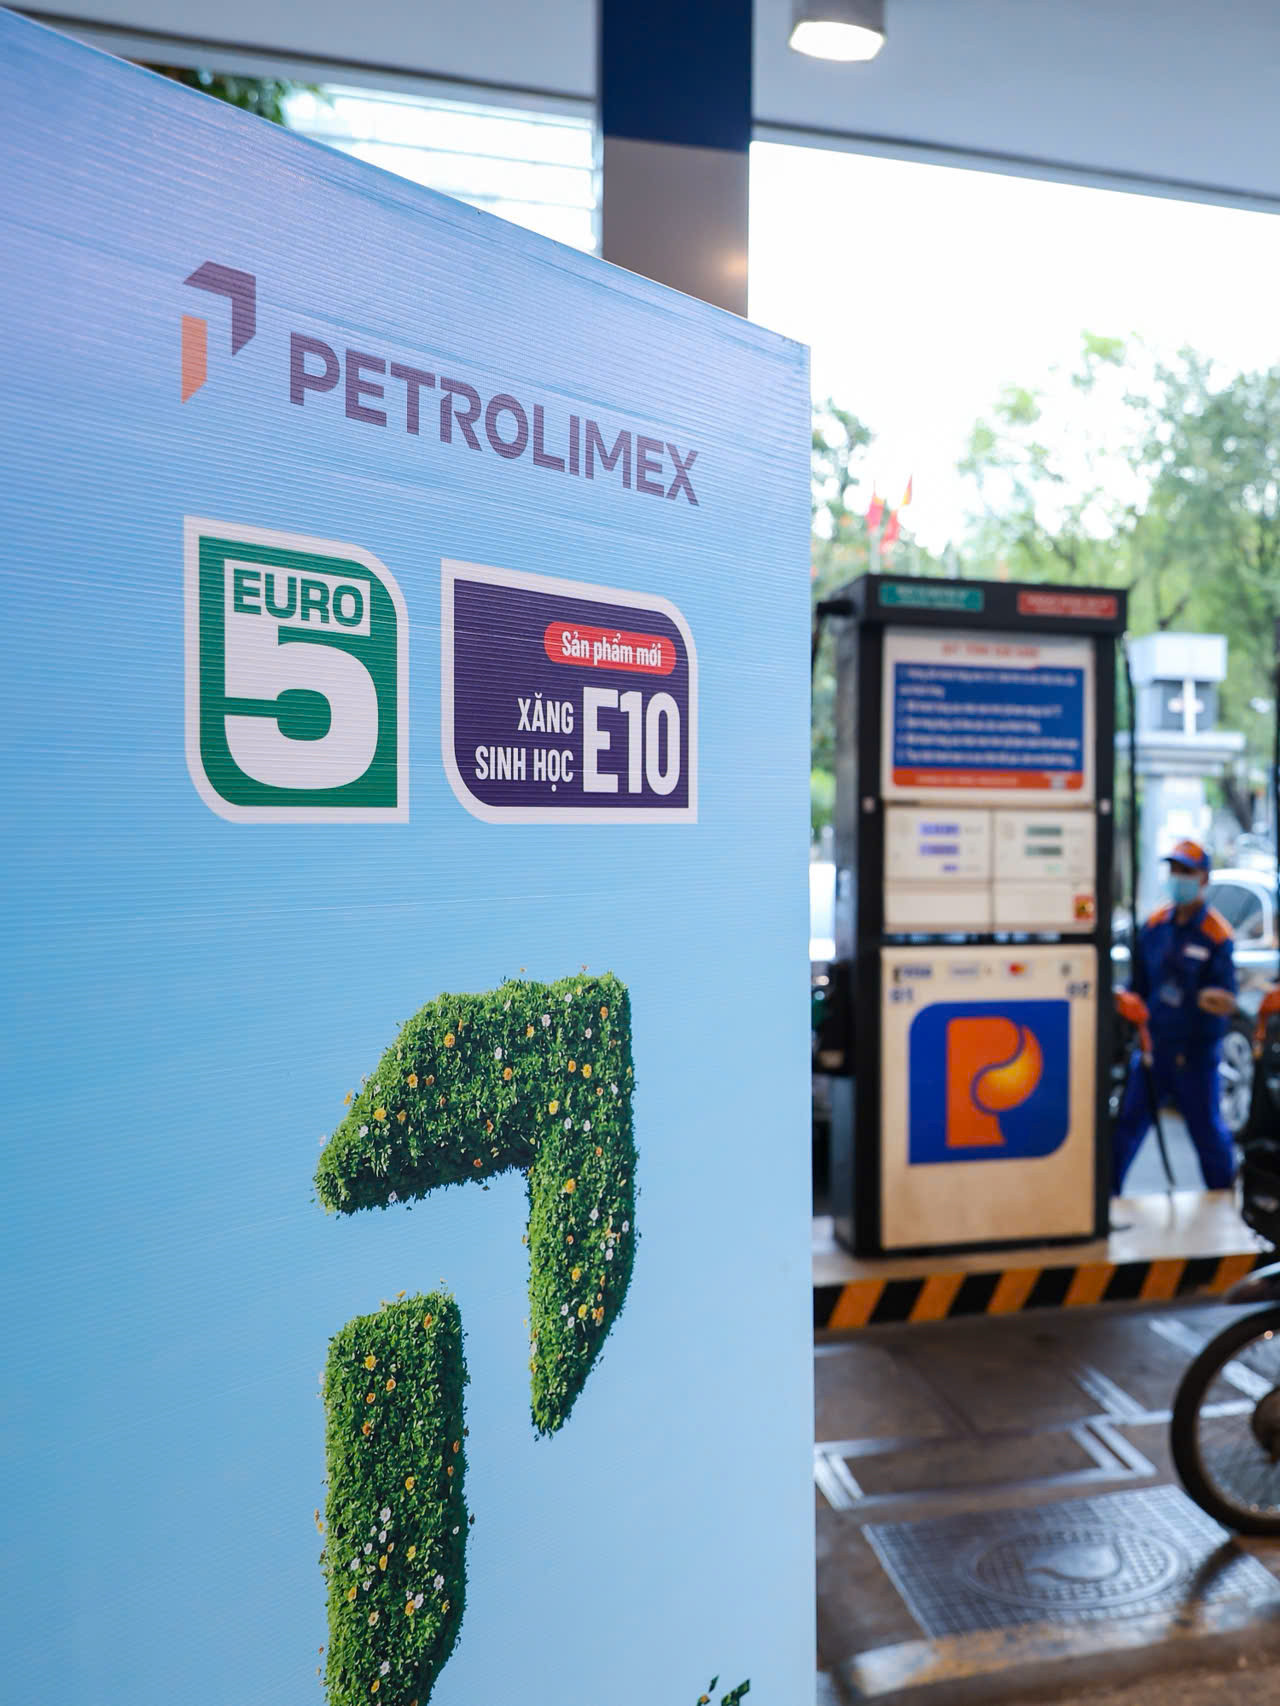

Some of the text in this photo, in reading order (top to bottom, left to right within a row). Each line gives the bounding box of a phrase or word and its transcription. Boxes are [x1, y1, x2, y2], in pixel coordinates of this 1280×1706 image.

[290, 332, 700, 506] PETROLIMEX
[233, 569, 364, 627] EURO
[562, 631, 662, 667] Sản phẩm mới
[224, 626, 379, 790] 5
[517, 692, 574, 734] XĂNG
[475, 746, 574, 792] SINH HỌC
[583, 687, 681, 796] E10
